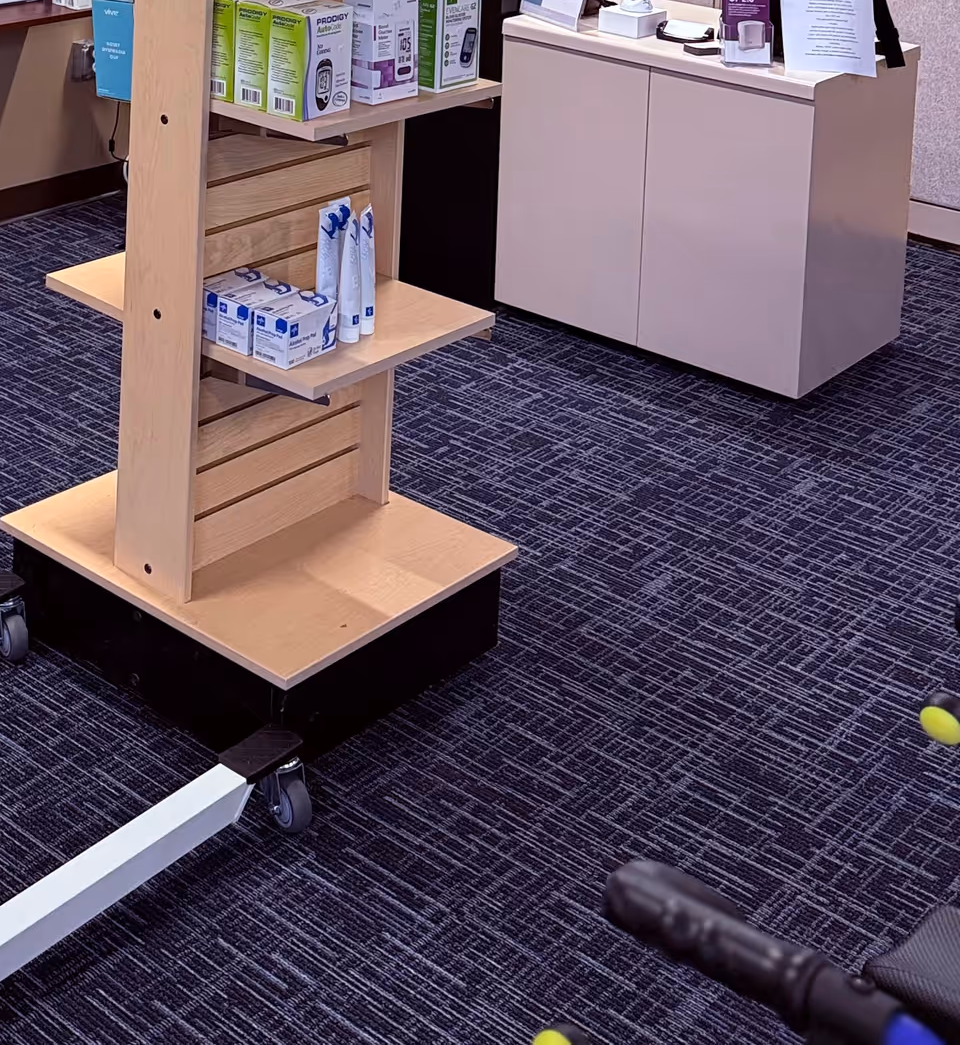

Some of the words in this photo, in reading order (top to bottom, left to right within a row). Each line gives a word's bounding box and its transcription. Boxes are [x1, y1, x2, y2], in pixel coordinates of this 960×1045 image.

[239, 8, 268, 16] PRODIGY
[446, 5, 470, 15] EVENCARE
[470, 2, 477, 11] G2
[272, 15, 302, 24] PRODIGY
[316, 12, 349, 26] PRODIGY
